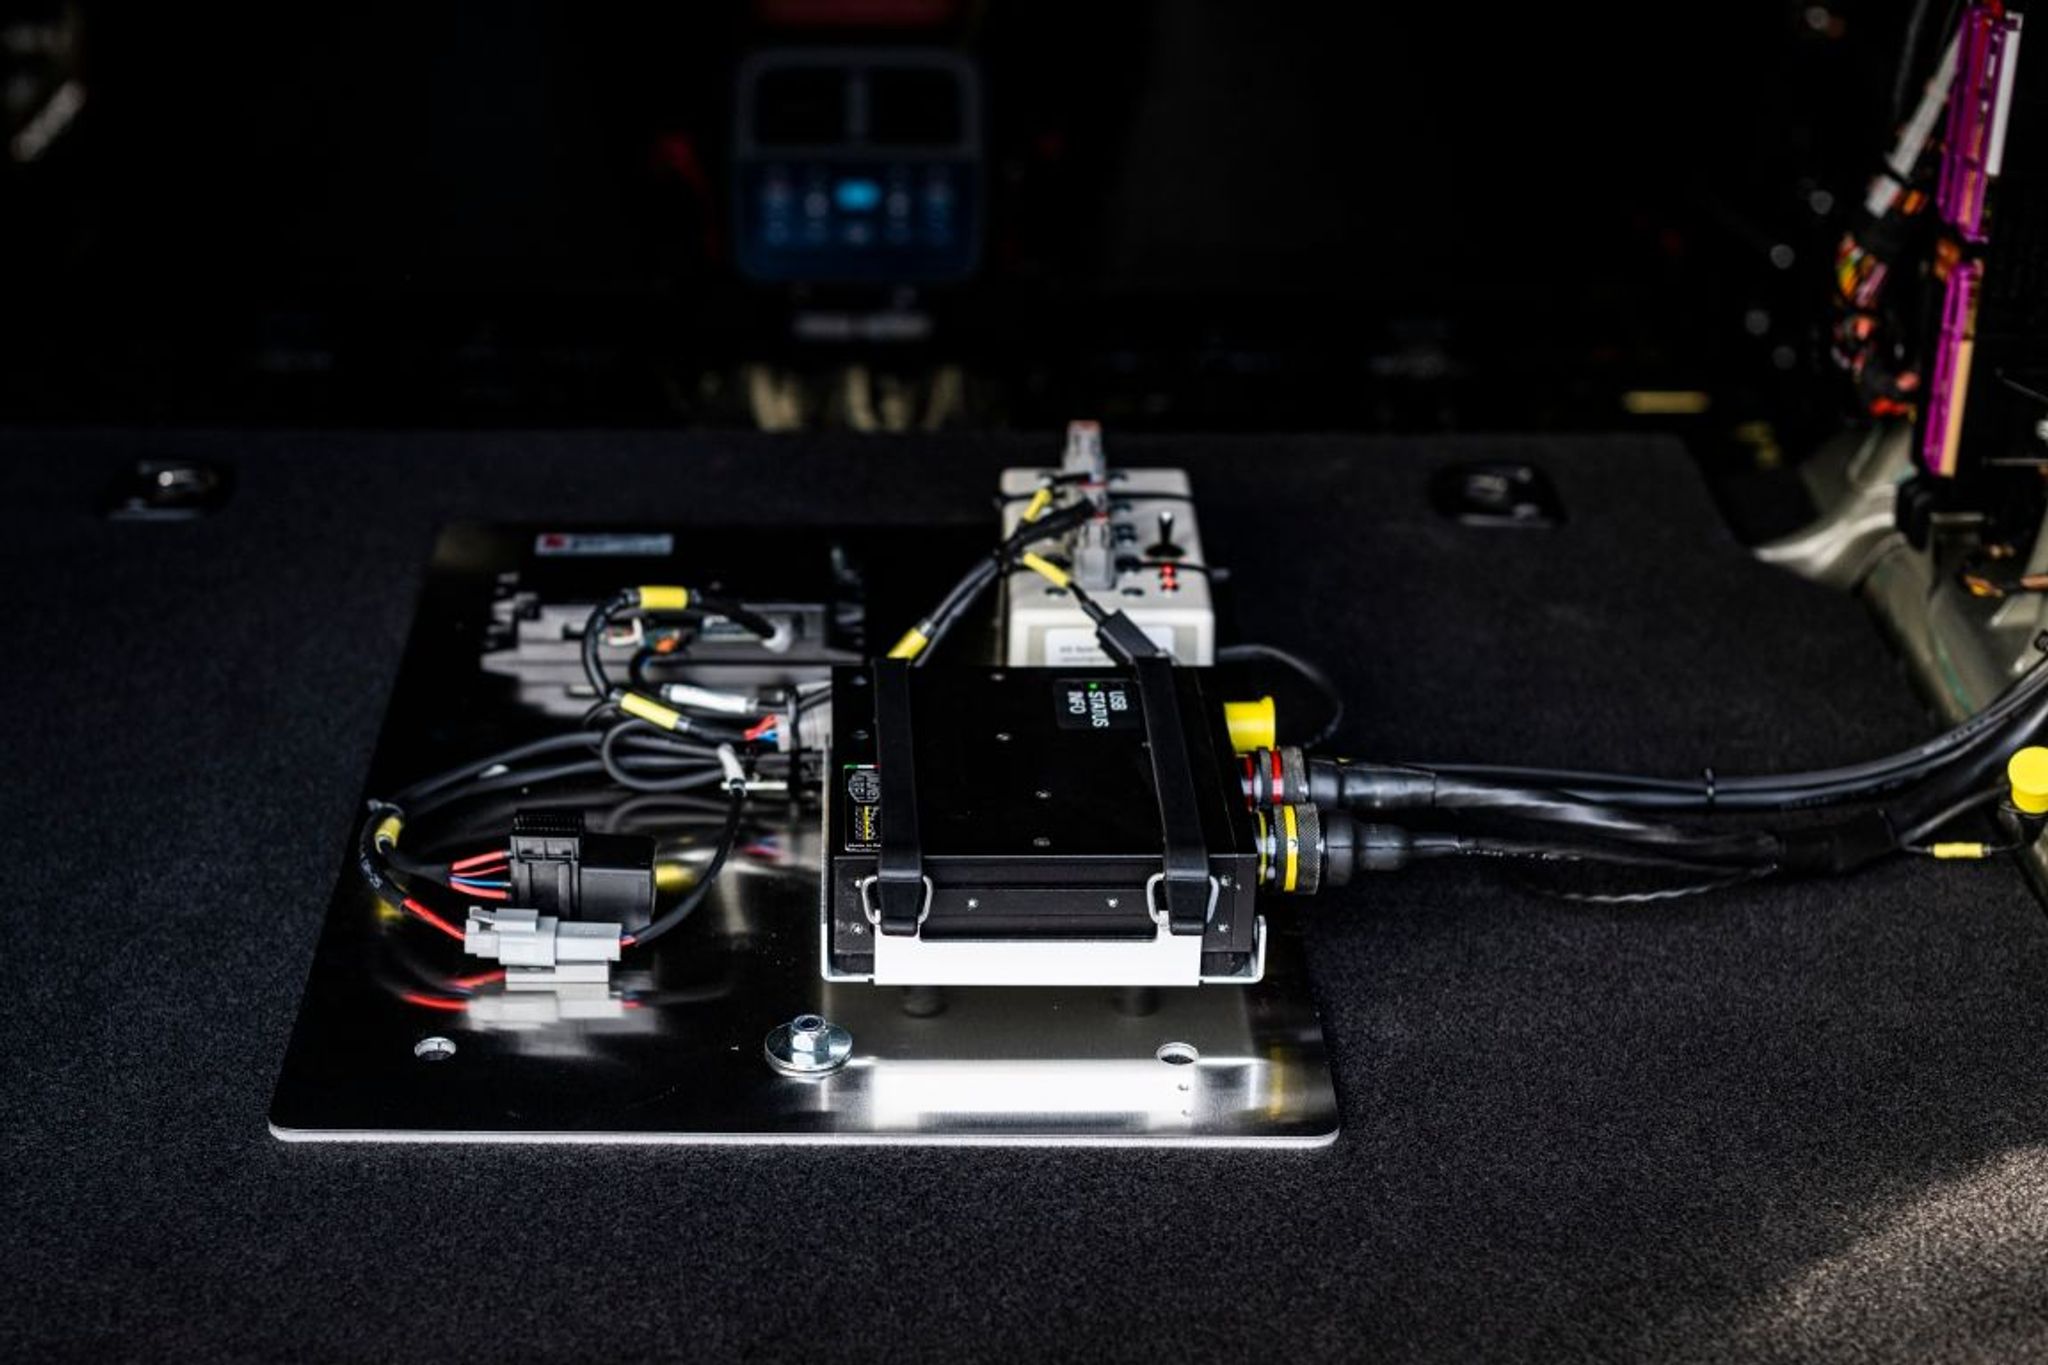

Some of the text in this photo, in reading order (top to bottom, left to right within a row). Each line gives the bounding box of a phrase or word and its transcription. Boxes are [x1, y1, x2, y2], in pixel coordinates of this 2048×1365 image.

[1068, 691, 1086, 713] INFO
[1089, 691, 1109, 727] STATUS
[1109, 691, 1127, 710] USB
